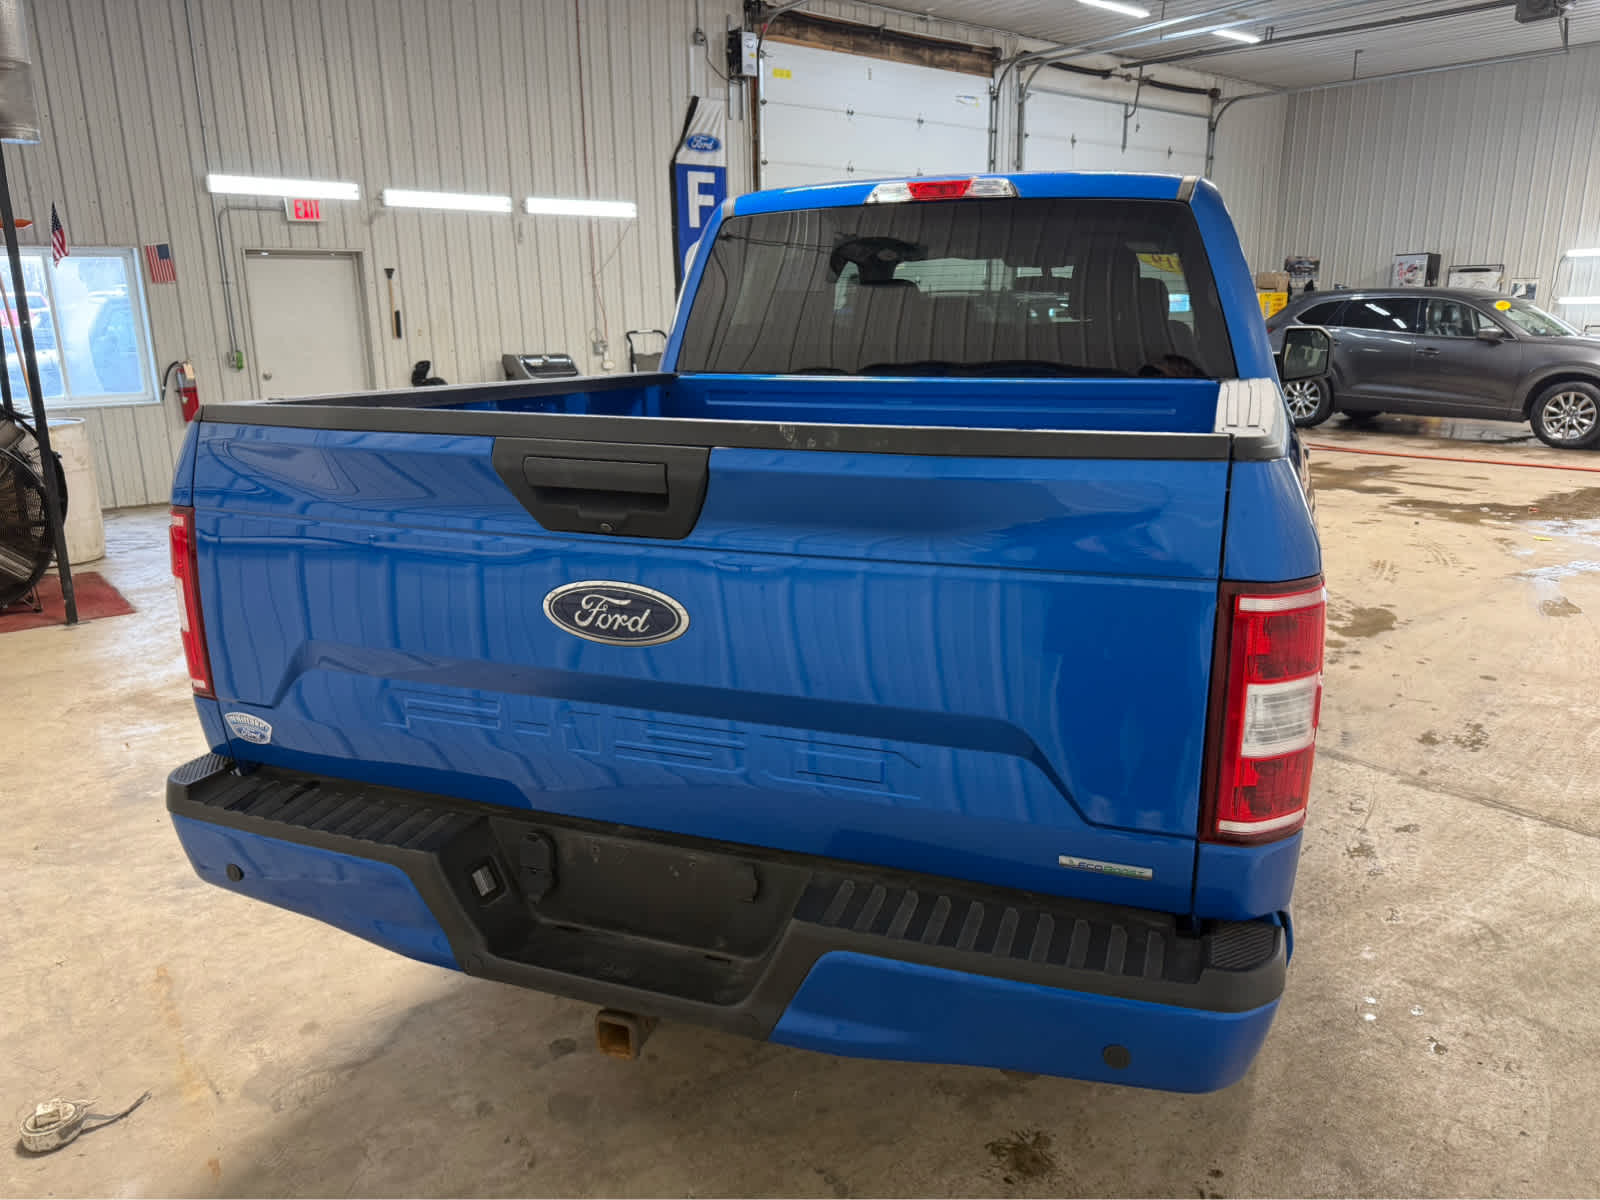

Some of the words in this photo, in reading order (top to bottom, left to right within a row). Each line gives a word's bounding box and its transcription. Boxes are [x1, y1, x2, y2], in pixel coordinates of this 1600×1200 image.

[690, 136, 714, 150] Ford
[294, 199, 320, 220] EXIT
[574, 594, 651, 633] Ford
